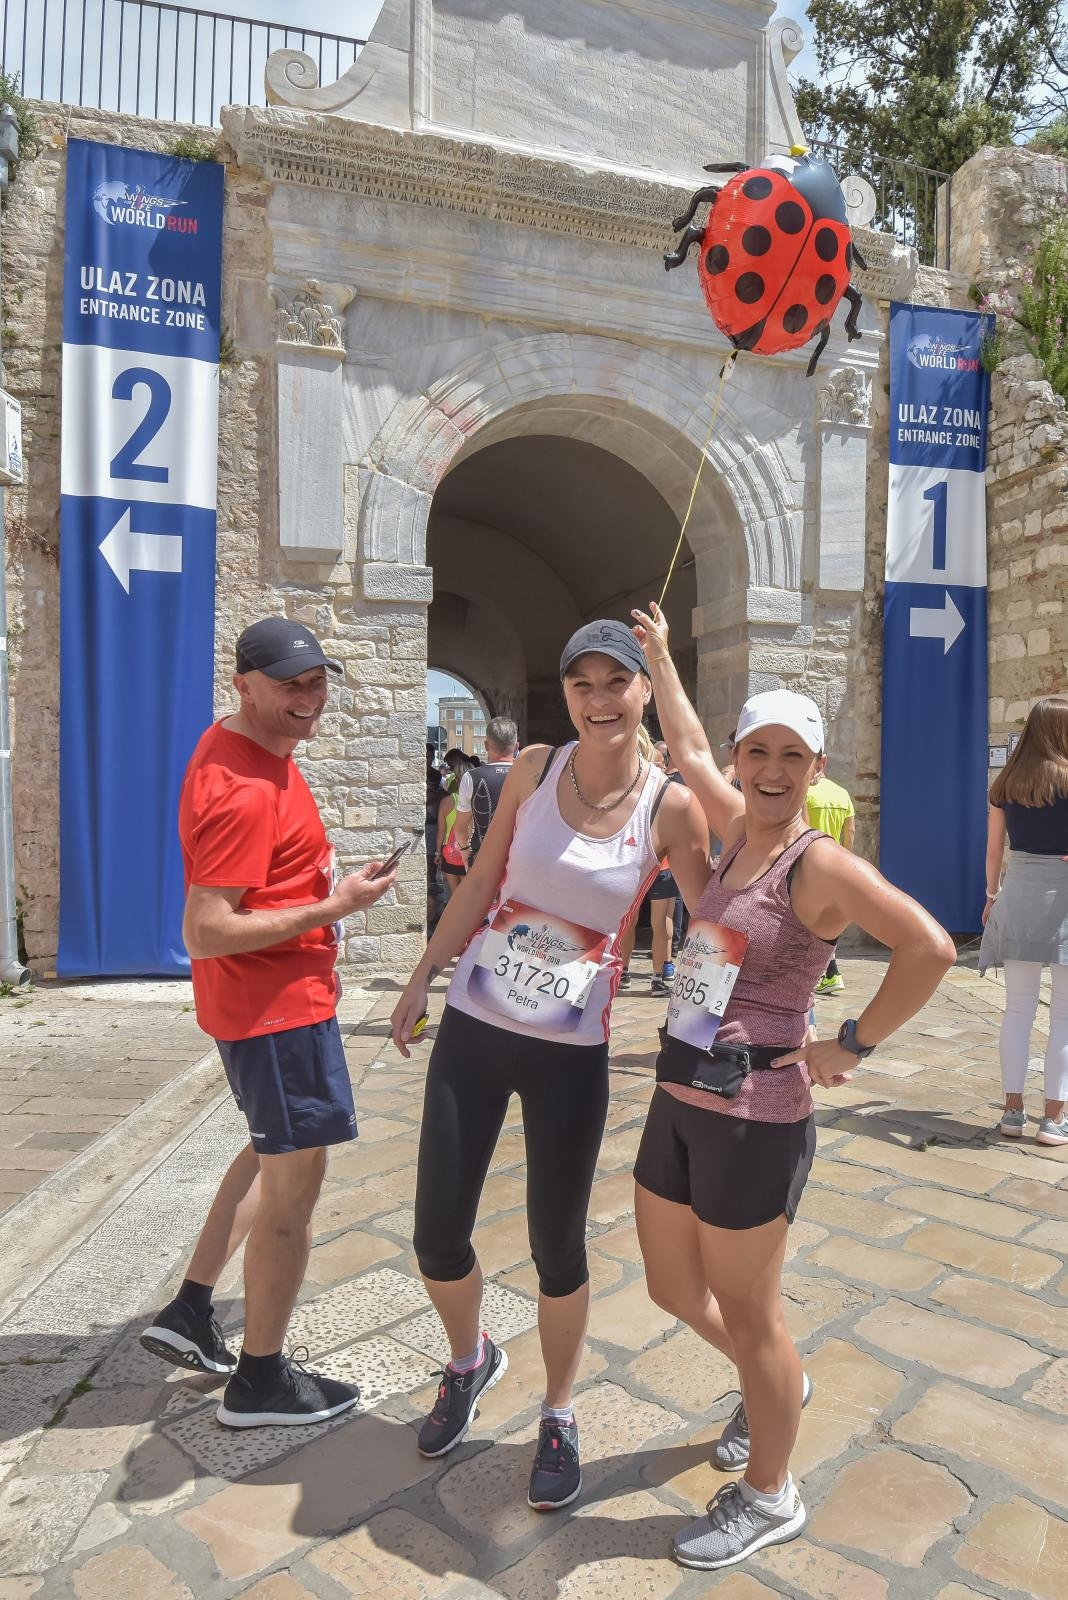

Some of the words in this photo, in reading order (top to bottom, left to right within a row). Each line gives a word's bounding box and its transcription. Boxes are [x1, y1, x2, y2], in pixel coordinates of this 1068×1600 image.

[126, 193, 164, 206] WINGS
[130, 201, 152, 212] LIFE
[111, 206, 165, 229] WORLD
[167, 215, 198, 234] RUN
[80, 266, 137, 297] ULAZ
[145, 275, 206, 307] ZONA
[80, 298, 160, 324] ENTRANCE
[165, 310, 205, 331] ZONE
[919, 354, 956, 370] WORLD
[957, 357, 979, 372] RUN
[109, 366, 173, 484] 2
[898, 403, 938, 425] ULAZ
[943, 407, 981, 430] ZONA
[898, 428, 952, 445] ENTRANCE
[956, 433, 980, 449] ZONE
[923, 481, 948, 571] 1
[516, 944, 536, 956] WORLD
[531, 931, 565, 949] WINGS
[531, 940, 553, 953] LIFE
[494, 954, 570, 999] 31720
[507, 988, 539, 1011] Petra
[714, 1000, 723, 1011] 2
